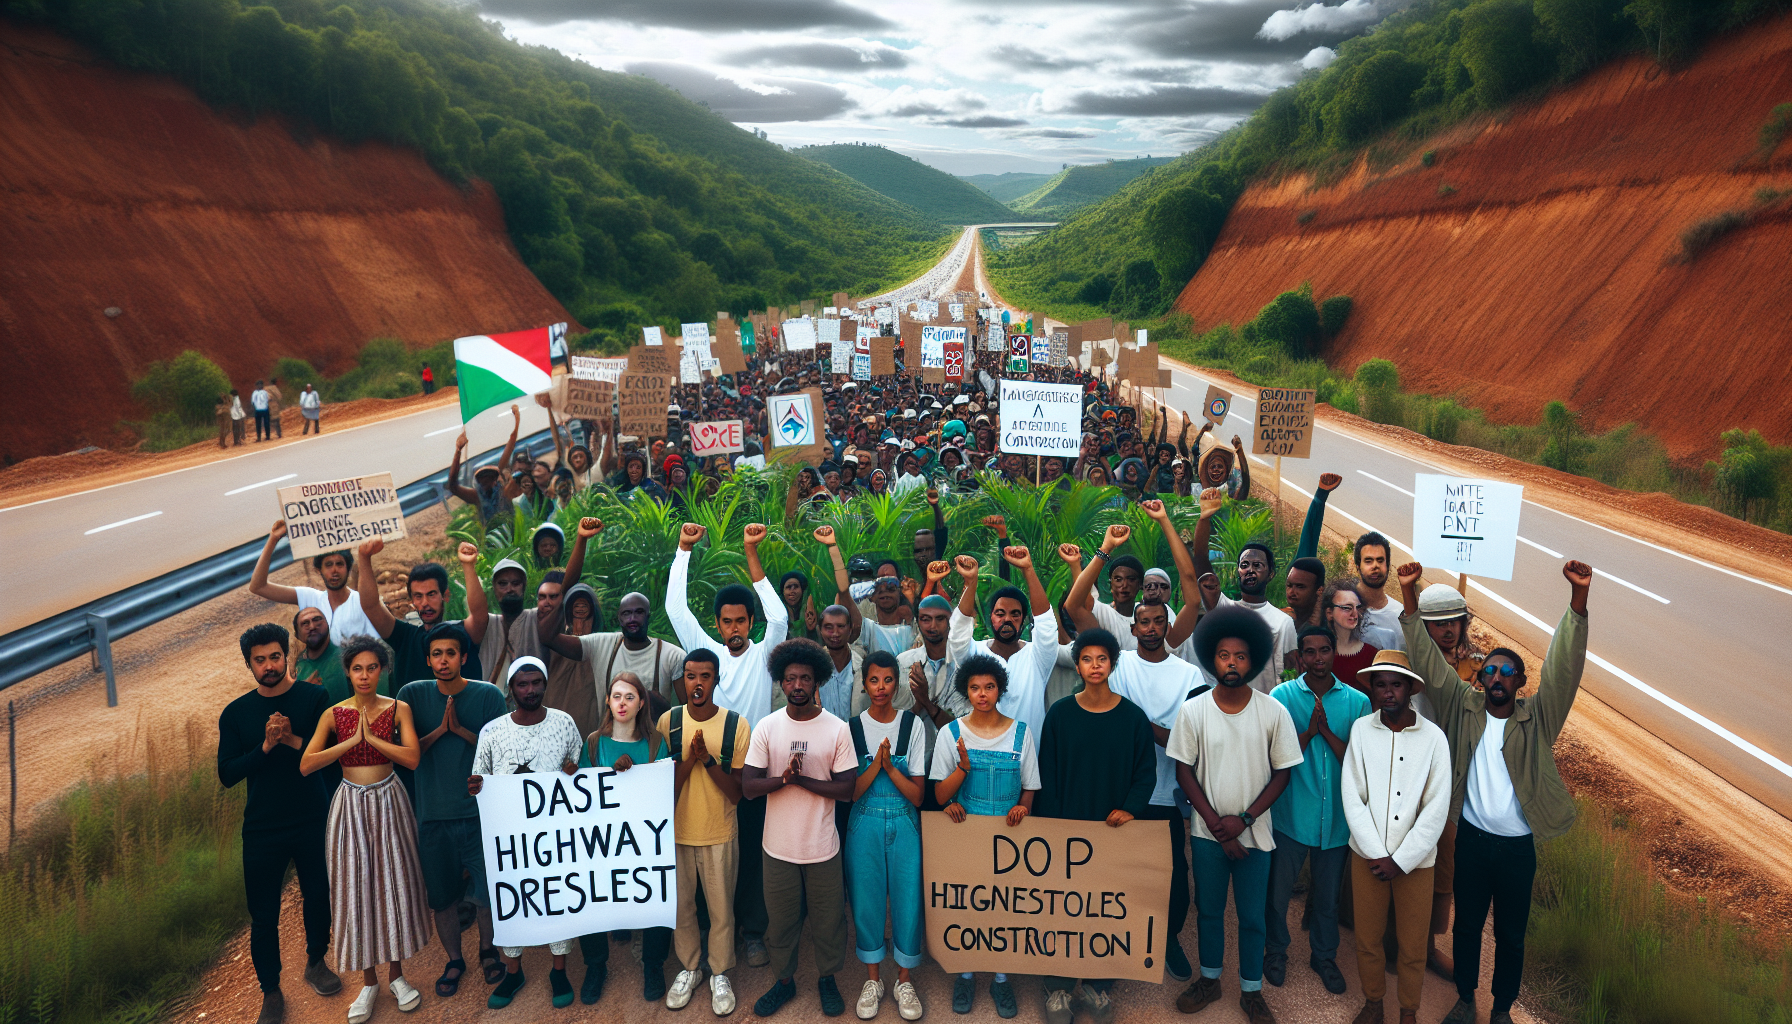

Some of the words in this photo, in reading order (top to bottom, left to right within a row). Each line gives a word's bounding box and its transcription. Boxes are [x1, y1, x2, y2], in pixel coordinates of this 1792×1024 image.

[523, 771, 620, 818] DASE
[495, 819, 668, 871] HIGHWAY
[495, 865, 675, 921] DRESLEST
